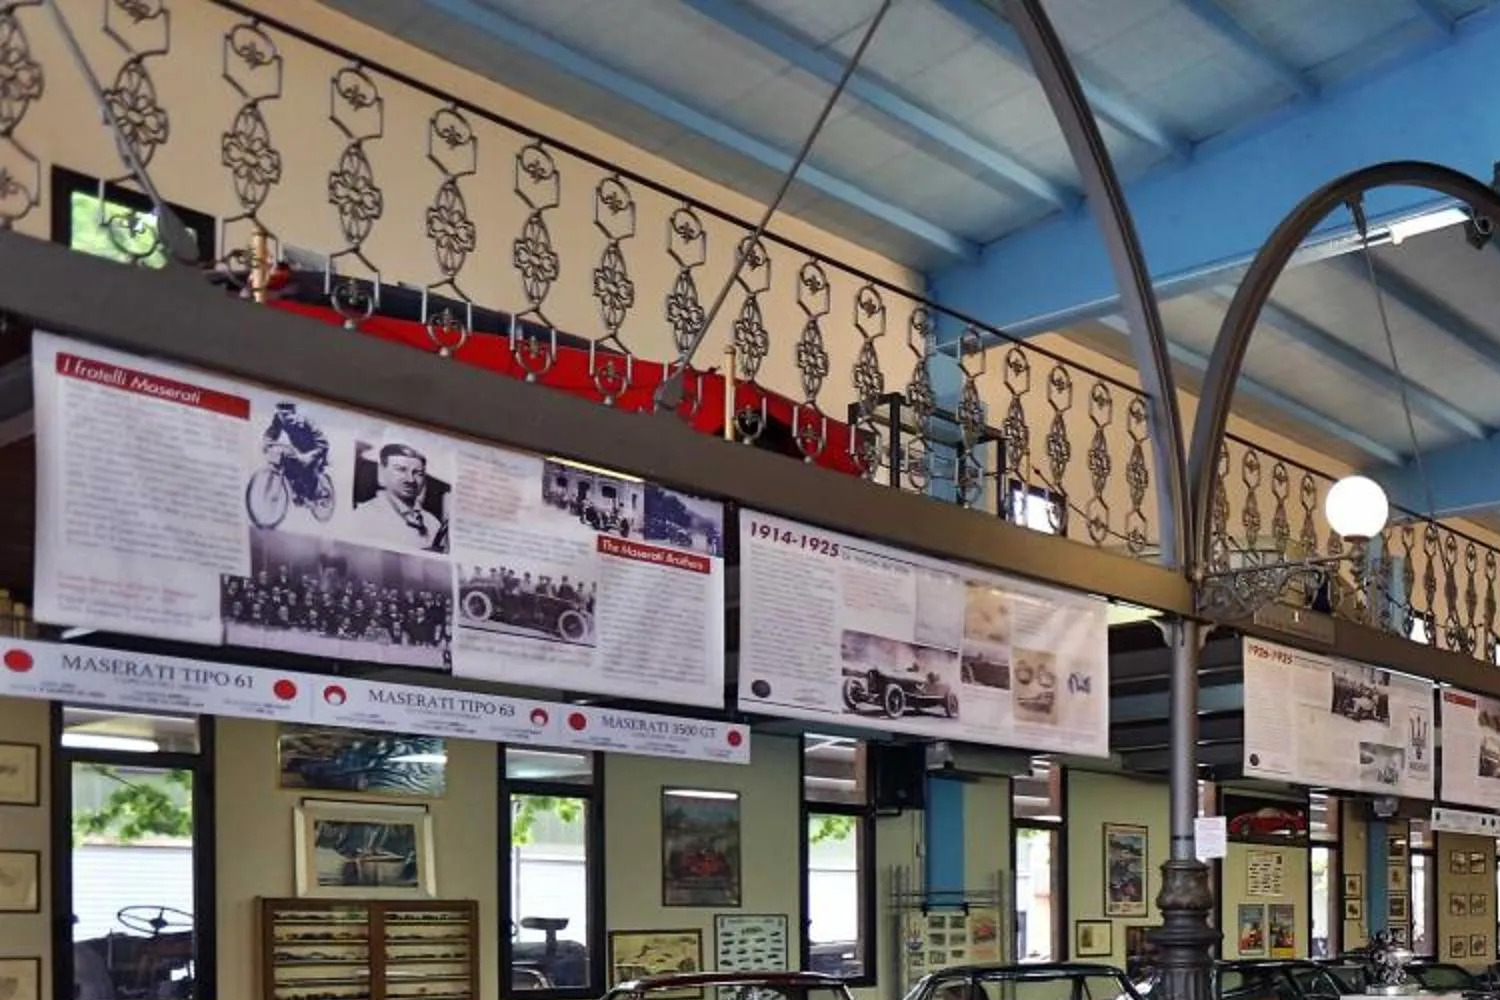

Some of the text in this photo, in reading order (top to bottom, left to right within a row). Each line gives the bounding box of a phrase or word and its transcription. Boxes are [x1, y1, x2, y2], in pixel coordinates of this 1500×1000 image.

[74, 360, 127, 385] fratelli
[130, 376, 201, 404] Maserati
[751, 521, 840, 558] 1914-1925
[61, 654, 254, 689] MASERATI TIPO 61
[368, 689, 516, 717] MASERATI TIPO 63
[601, 715, 669, 734] MASERATI
